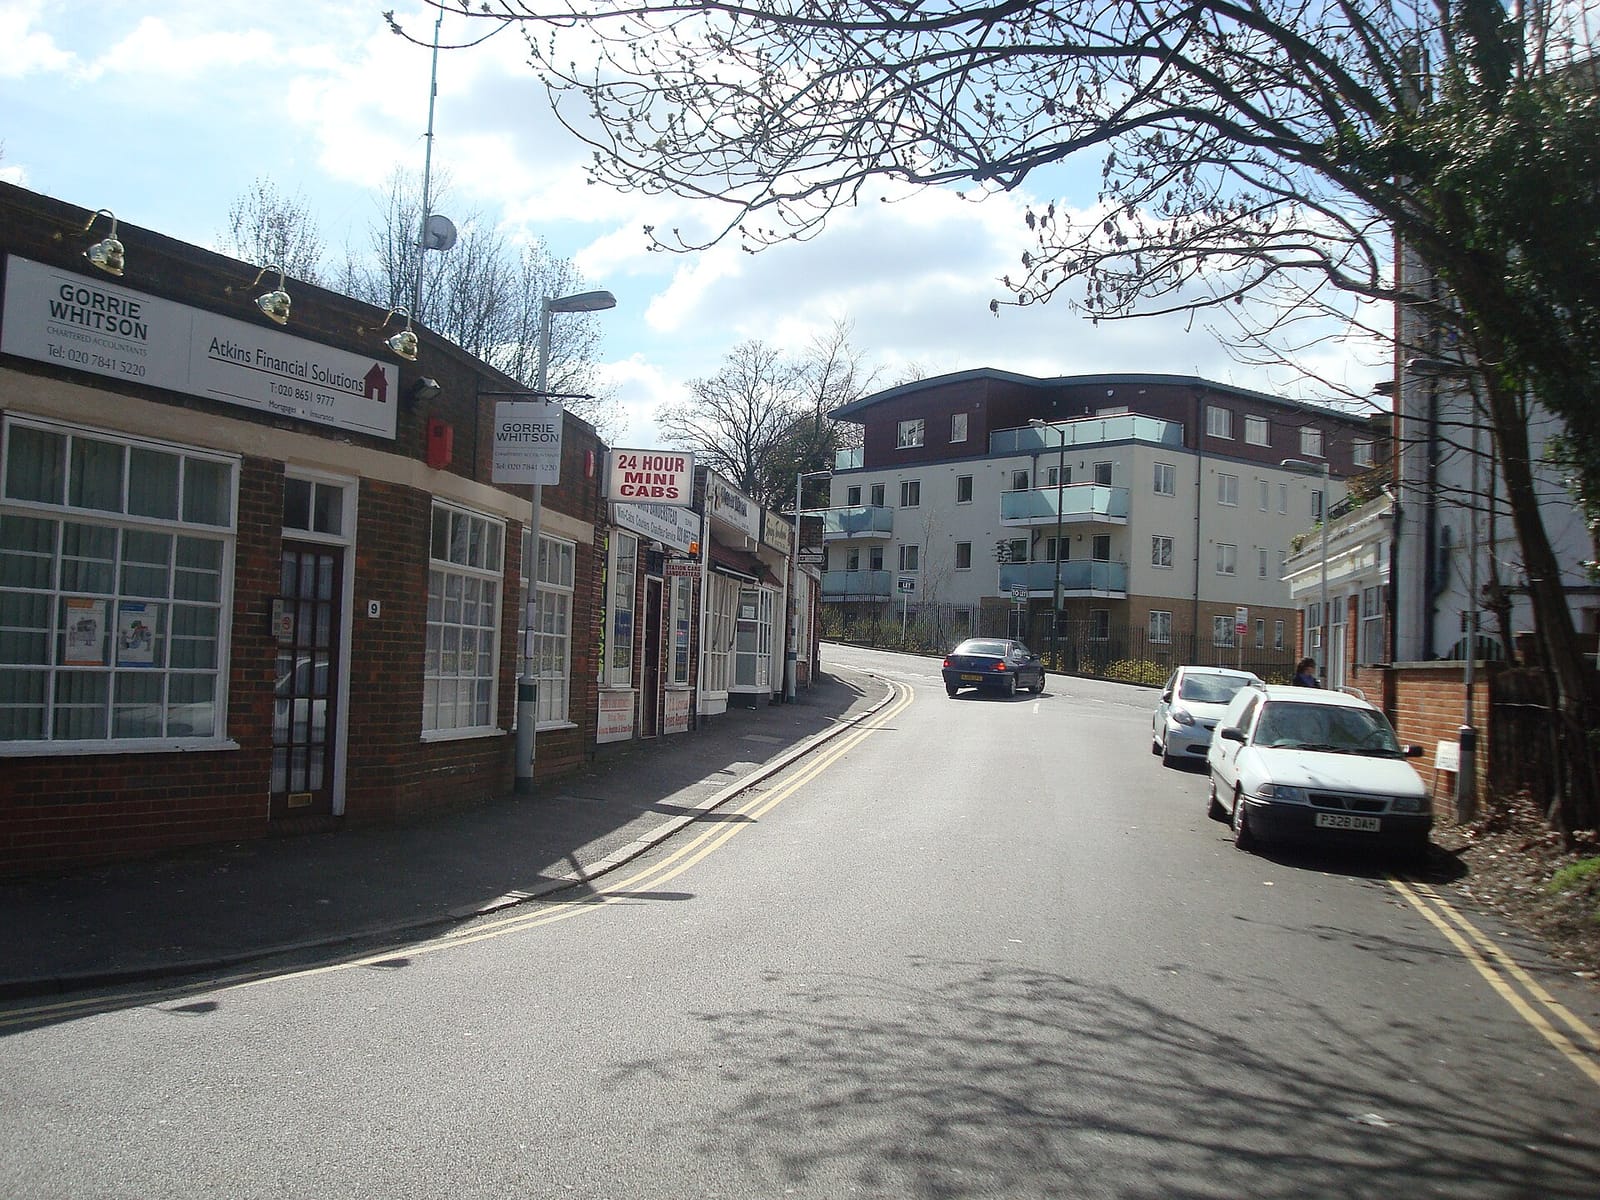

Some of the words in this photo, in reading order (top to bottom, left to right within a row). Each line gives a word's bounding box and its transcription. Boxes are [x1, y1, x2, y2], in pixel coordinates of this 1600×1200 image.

[59, 284, 141, 319] GORRIE
[49, 300, 148, 341] WHITSON
[47, 326, 91, 344] CHARTERED
[92, 337, 148, 357] ACCOUNTANTS
[47, 344, 65, 359] Tel:
[68, 348, 89, 365] 020
[91, 354, 117, 370] 7841
[119, 361, 146, 378] 5220
[208, 337, 252, 363] Atkins
[255, 348, 308, 378] Financial
[311, 364, 364, 393] Solutions
[295, 388, 314, 403] 8651
[316, 395, 335, 408] 9777
[502, 423, 555, 433] GORRIE
[496, 433, 559, 443] WHITSON
[618, 455, 637, 470] 24
[642, 456, 685, 473] HOUR
[624, 472, 675, 486] MINI
[620, 485, 680, 499] CABS
[370, 603, 378, 615] 9
